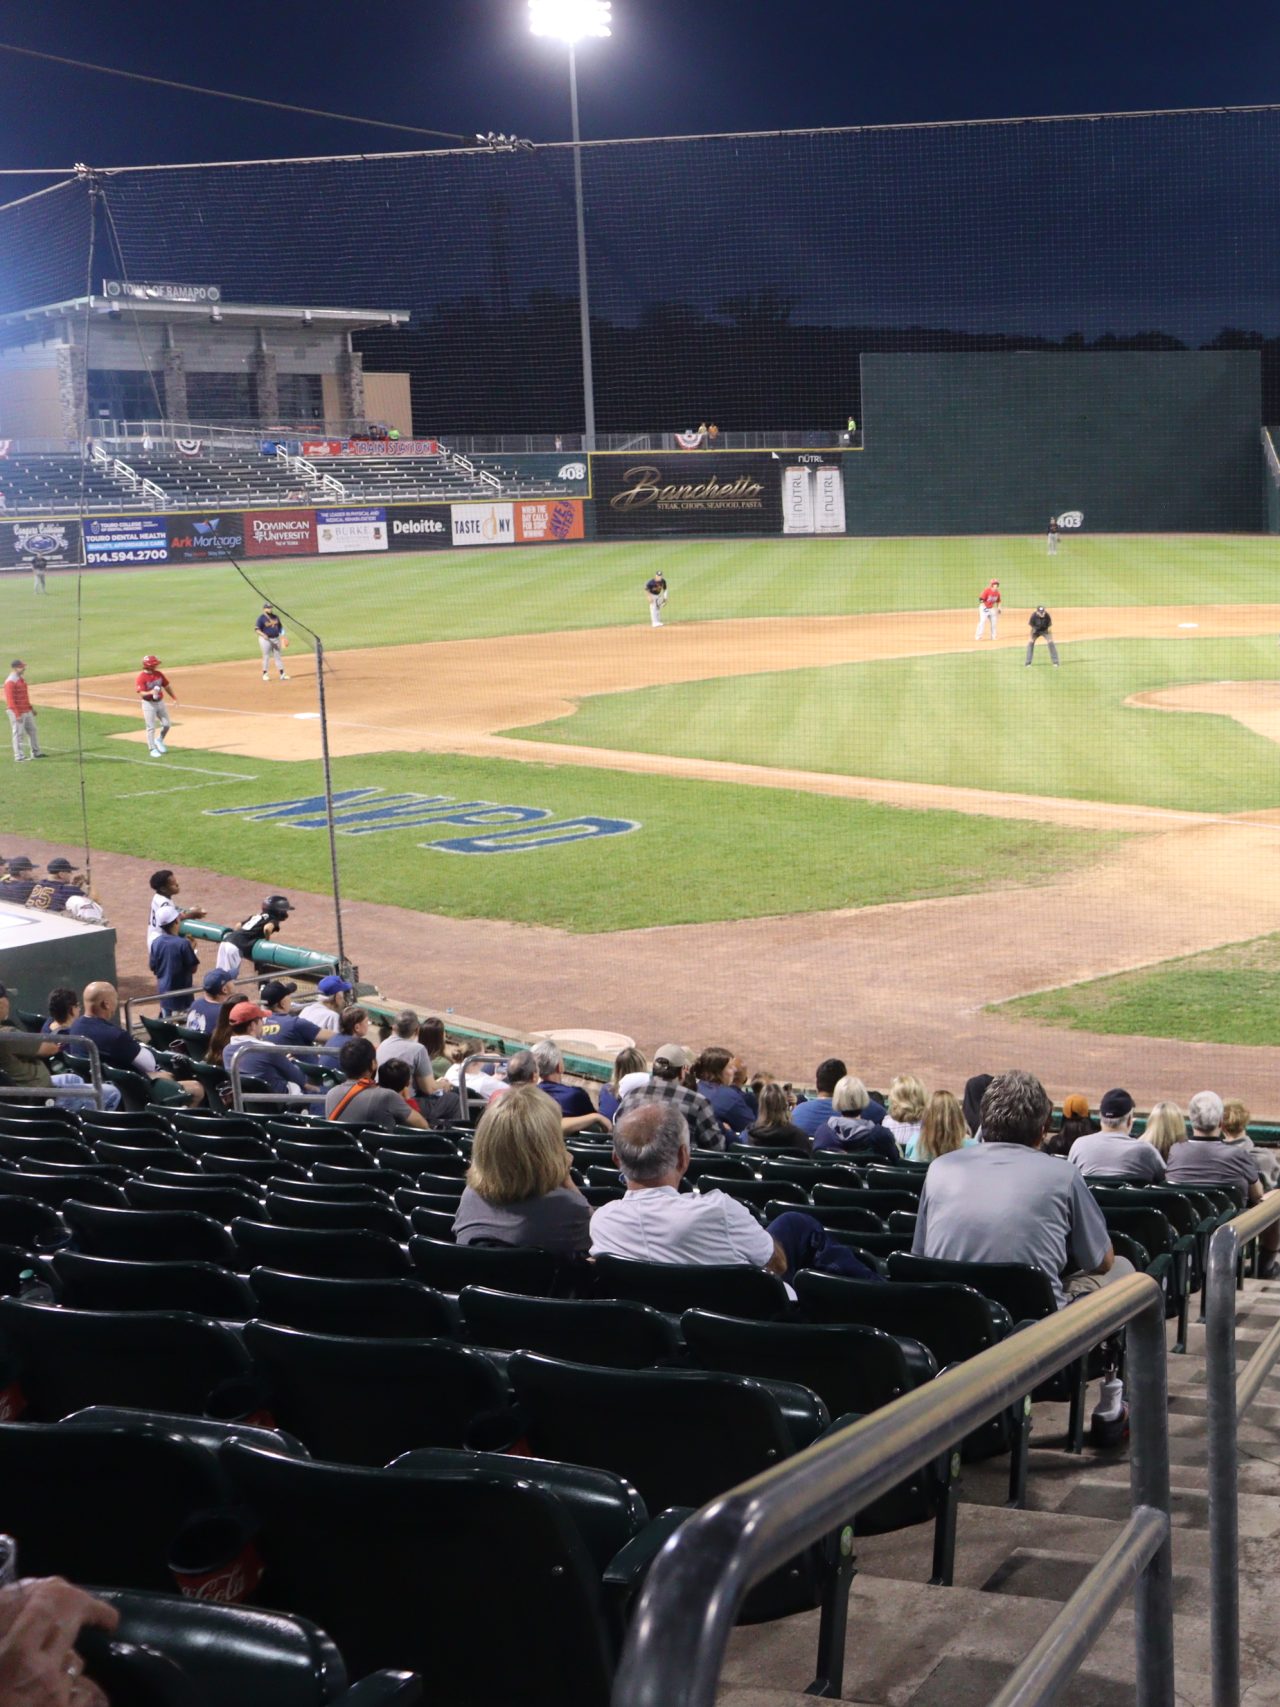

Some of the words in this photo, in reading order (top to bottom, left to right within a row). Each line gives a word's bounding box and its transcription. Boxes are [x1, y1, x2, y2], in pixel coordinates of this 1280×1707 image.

[122, 283, 149, 296] TOWN
[151, 286, 165, 297] OF
[167, 286, 206, 299] RAMAPO
[355, 442, 385, 455] TRAIN
[387, 441, 432, 455] STATION
[558, 467, 585, 480] 408
[610, 465, 765, 511] Banchetto
[657, 502, 680, 510] STEAK,
[706, 501, 741, 509] SEAFOOD,
[741, 501, 762, 509] PASTA
[253, 520, 310, 531] DOMINICAN
[393, 519, 446, 534] Deloitte.
[454, 519, 481, 534] TASTE
[499, 518, 511, 532] NY
[1057, 516, 1082, 528] 403
[86, 534, 111, 542] TOURO
[111, 533, 139, 541] DENTAL
[139, 532, 167, 540] HEALTH
[170, 536, 192, 548] Ark
[193, 535, 242, 549] Mortgage
[264, 531, 310, 541] UNIVERSITY
[87, 549, 168, 563] 914.594.2700
[200, 787, 642, 855] NYPD
[25, 884, 56, 909] 25
